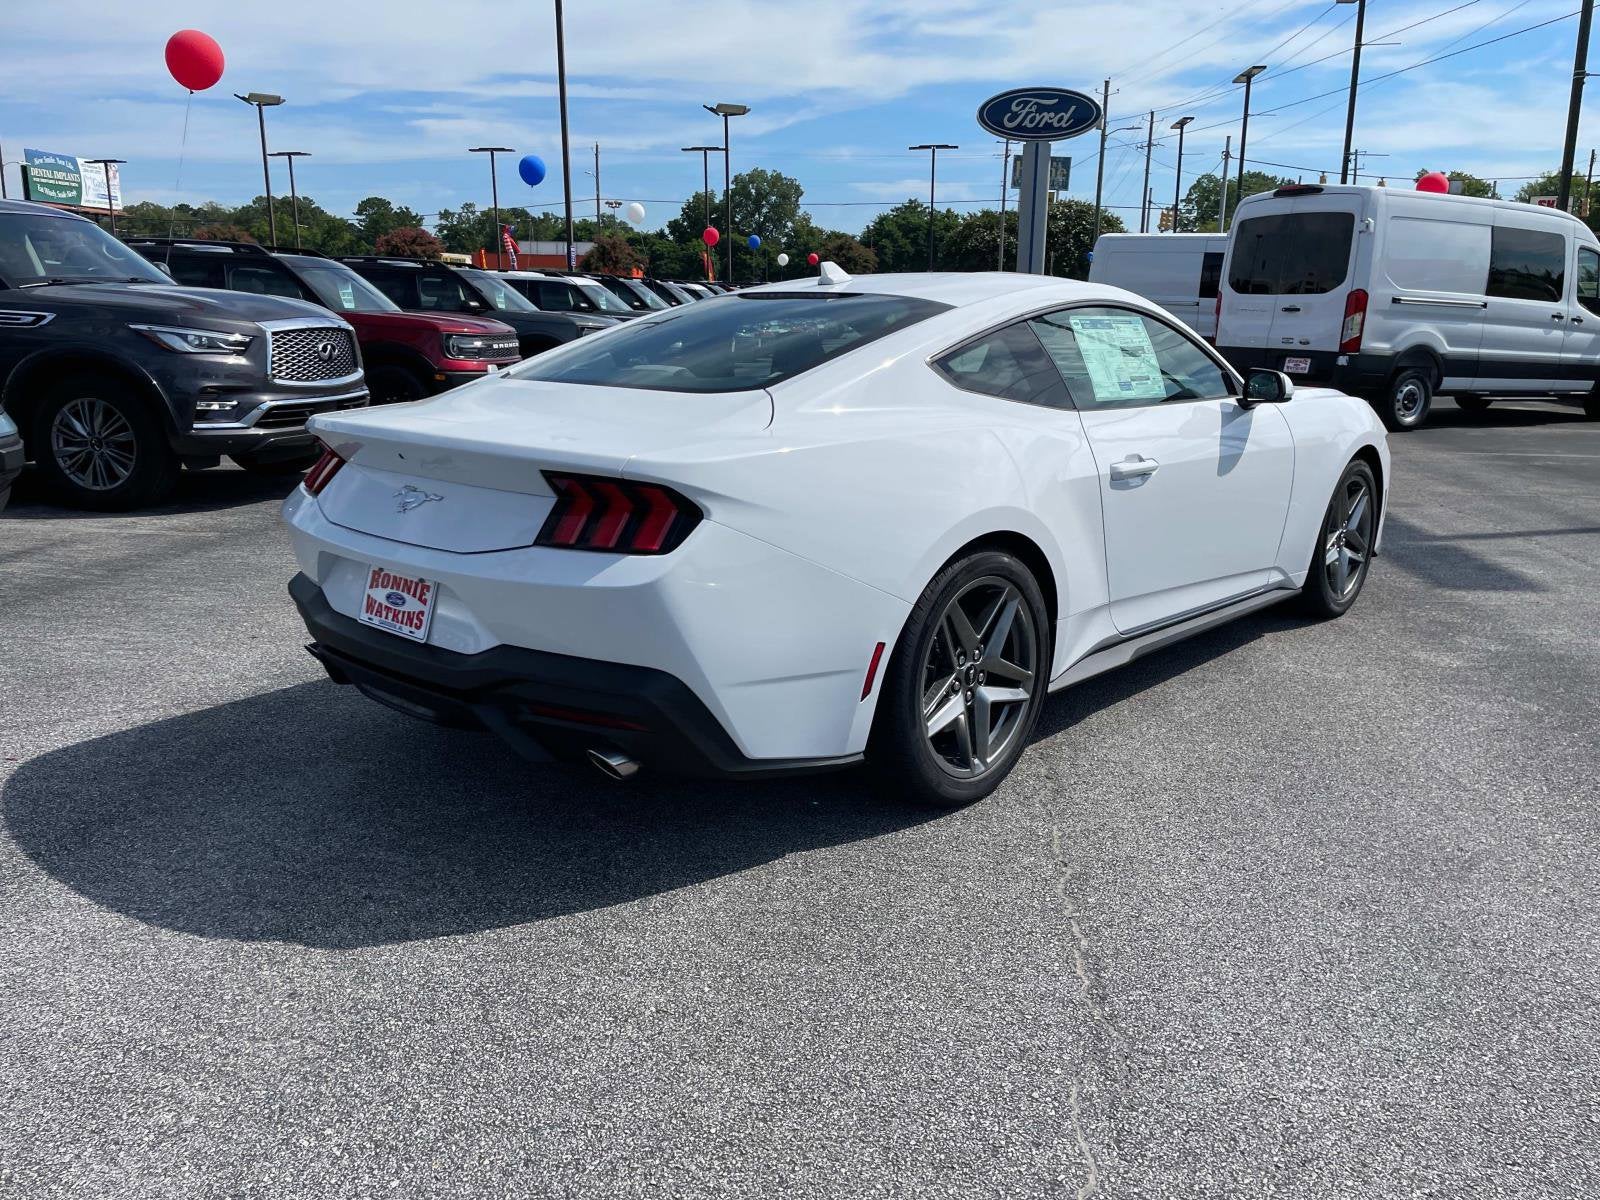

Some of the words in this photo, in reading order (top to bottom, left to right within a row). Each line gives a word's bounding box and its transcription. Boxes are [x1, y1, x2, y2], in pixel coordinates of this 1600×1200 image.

[1003, 97, 1077, 128] Ford
[30, 167, 53, 178] DENTAL
[53, 170, 80, 182] IMPLANTS
[369, 569, 431, 607] RONNIE
[365, 593, 425, 630] WATKINS
